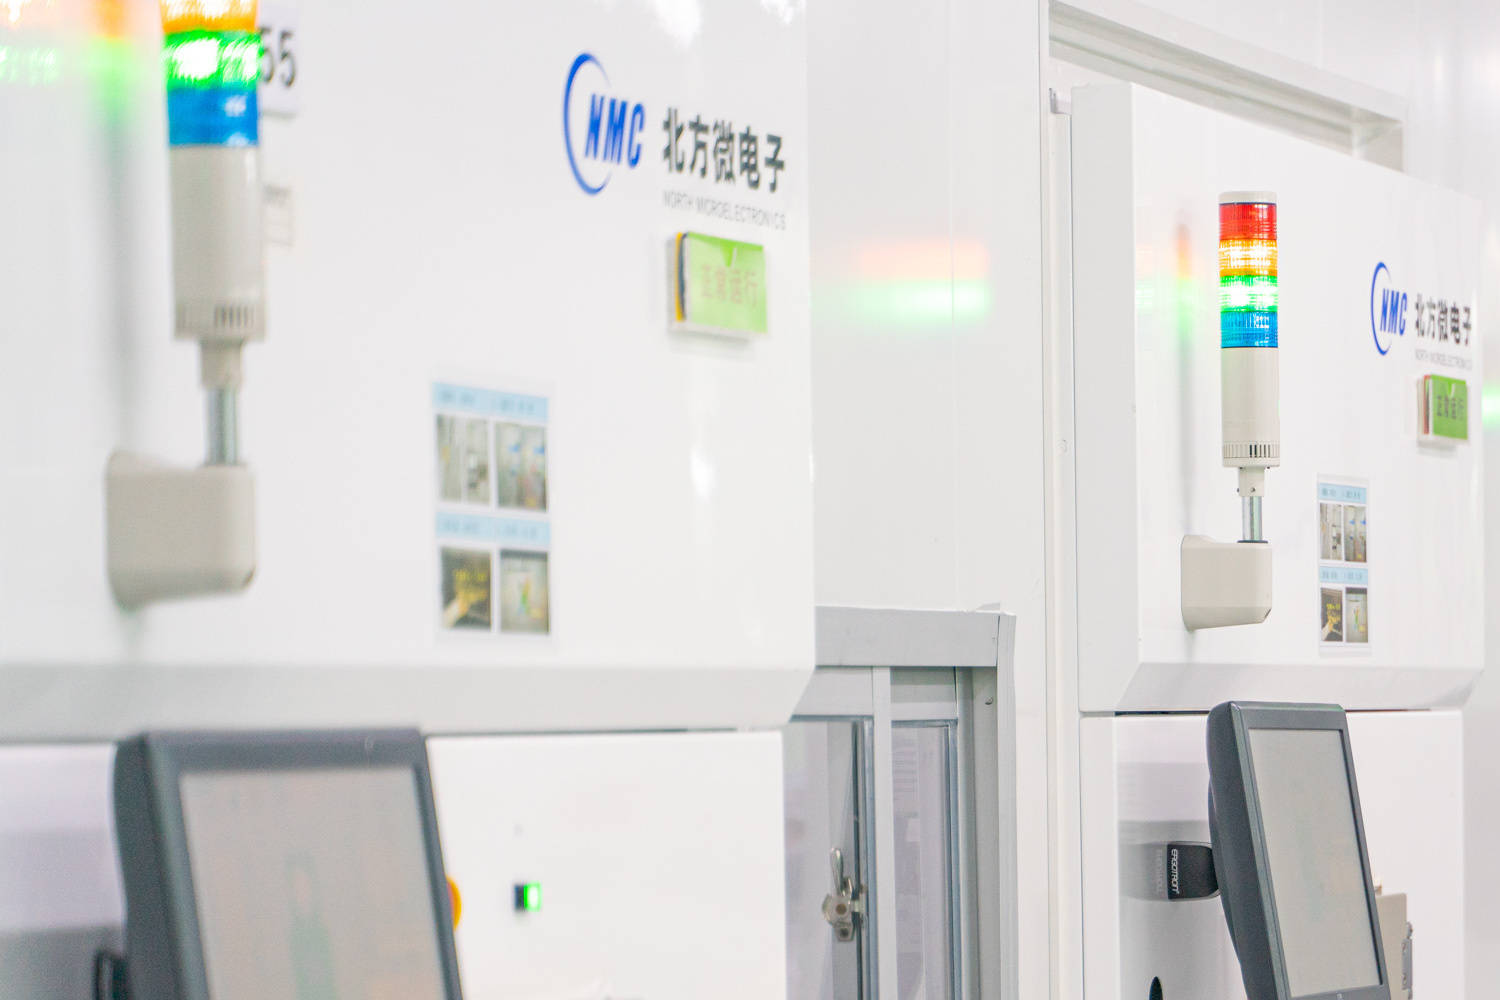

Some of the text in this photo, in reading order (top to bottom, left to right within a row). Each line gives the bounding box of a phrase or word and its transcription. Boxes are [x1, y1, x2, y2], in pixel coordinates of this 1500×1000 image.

[585, 93, 646, 169] NMC
[662, 106, 785, 193] 北方微电子
[1380, 287, 1408, 336] NMC
[1415, 293, 1472, 346] 北方微电子
[1171, 848, 1179, 893] ERGOTRON
